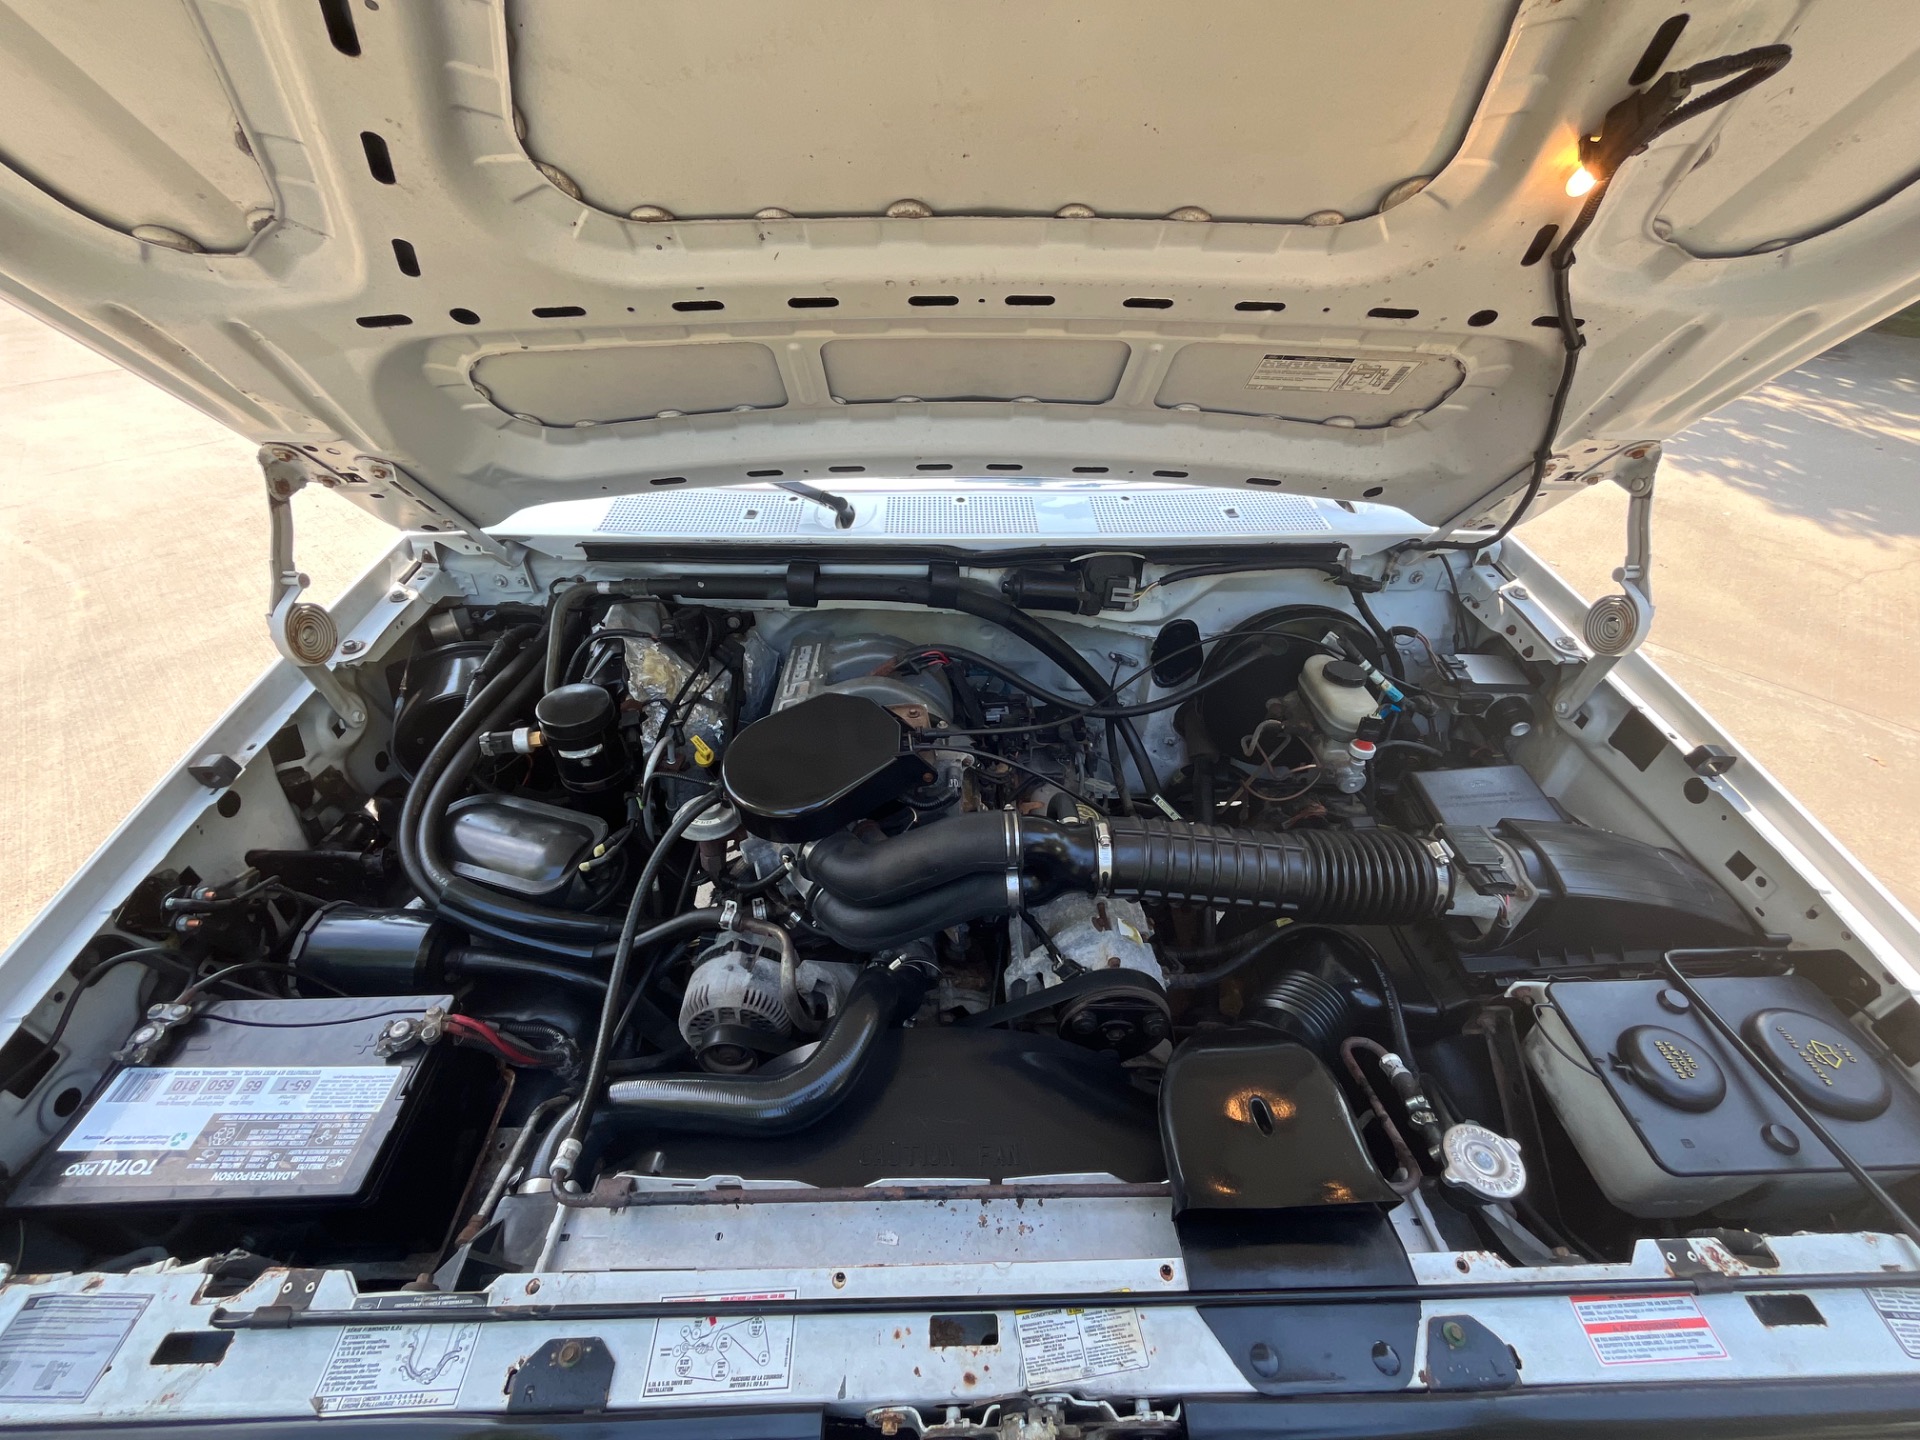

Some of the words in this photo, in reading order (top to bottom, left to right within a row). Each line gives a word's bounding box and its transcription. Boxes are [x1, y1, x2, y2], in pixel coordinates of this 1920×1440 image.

[1776, 1025, 1799, 1049] FLUID
[1653, 1040, 1687, 1079] RADIATOR
[1662, 1041, 1695, 1078] COOLANT
[1679, 1049, 1699, 1070] ONLY
[1835, 1042, 1857, 1063] ONLY
[1799, 1050, 1833, 1086] WASHER
[172, 1080, 201, 1091] 810
[207, 1080, 235, 1091] 650
[242, 1080, 263, 1092] 65
[278, 1080, 312, 1092] 65-T
[859, 1143, 956, 1167] CAUTION
[978, 1143, 1023, 1167] FAN
[210, 1171, 251, 1181] POISON
[522, 1385, 536, 1404] R
